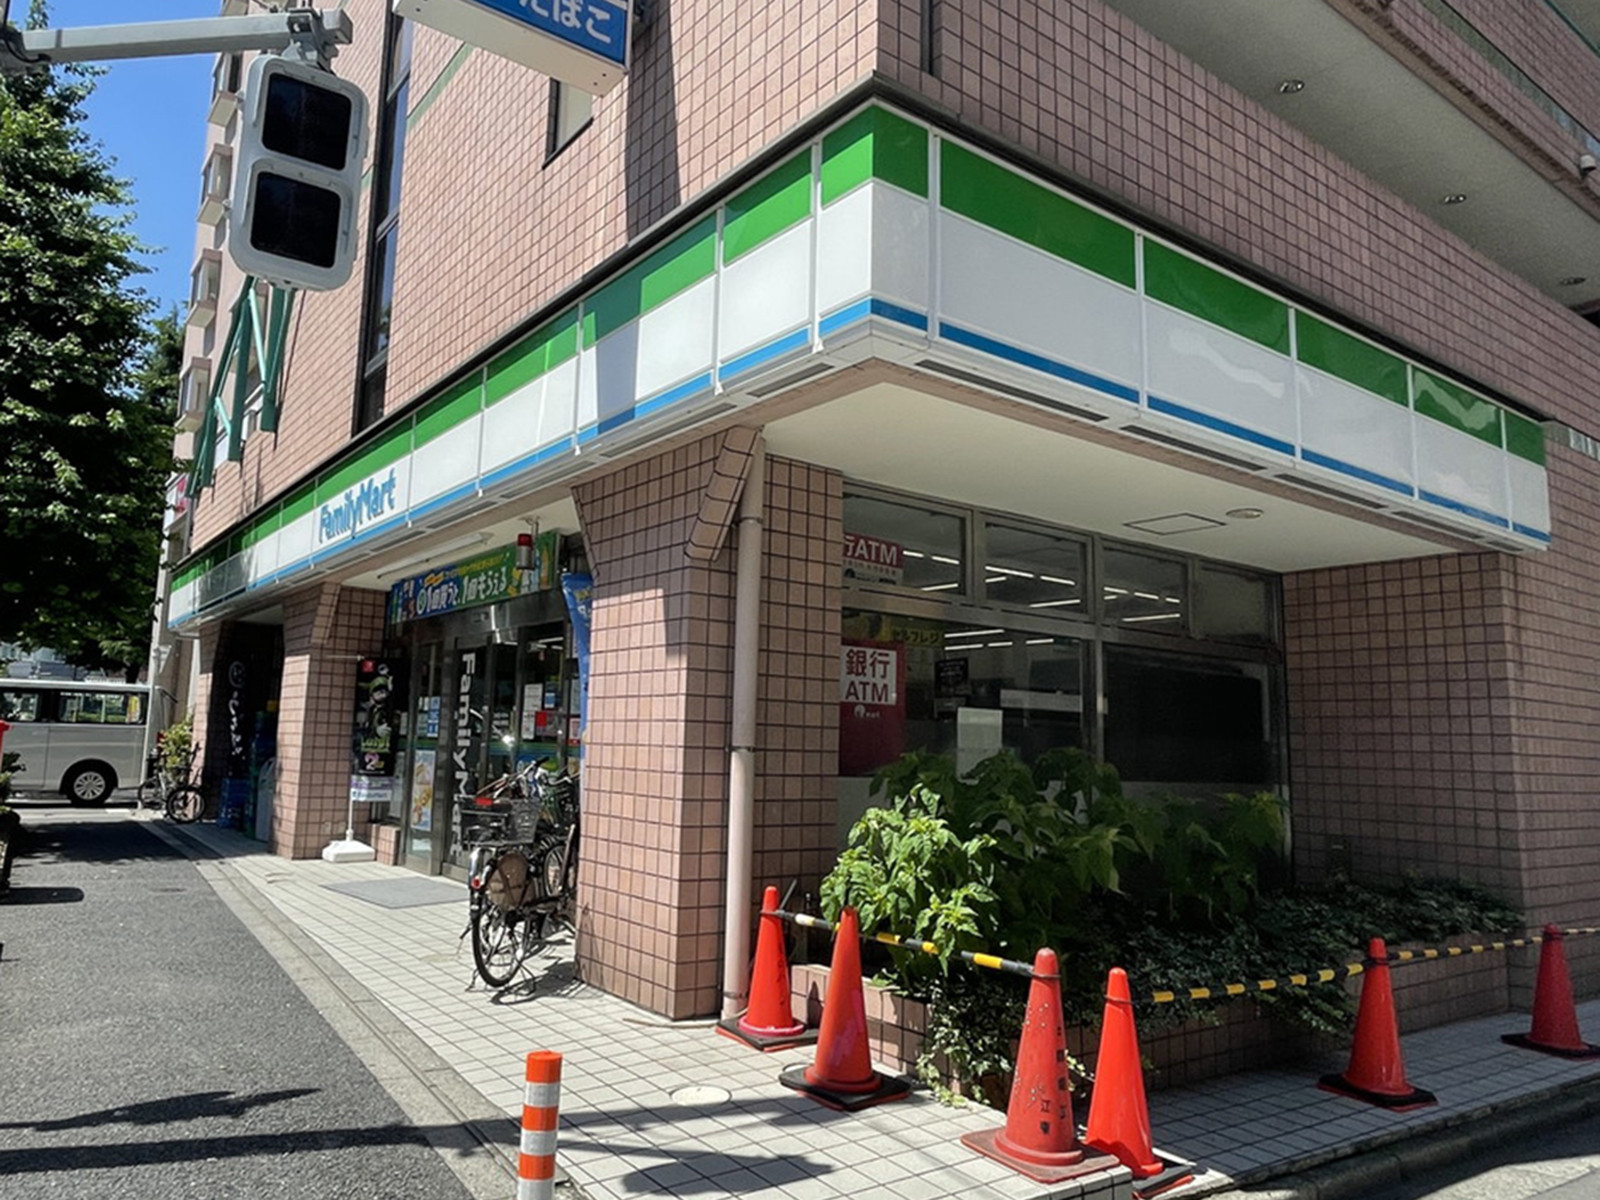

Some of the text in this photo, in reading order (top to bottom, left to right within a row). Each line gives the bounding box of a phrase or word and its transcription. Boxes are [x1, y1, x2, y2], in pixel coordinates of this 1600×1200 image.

[319, 467, 396, 544] FamilyMart
[846, 648, 890, 679] 銀行
[845, 681, 889, 703] ATM
